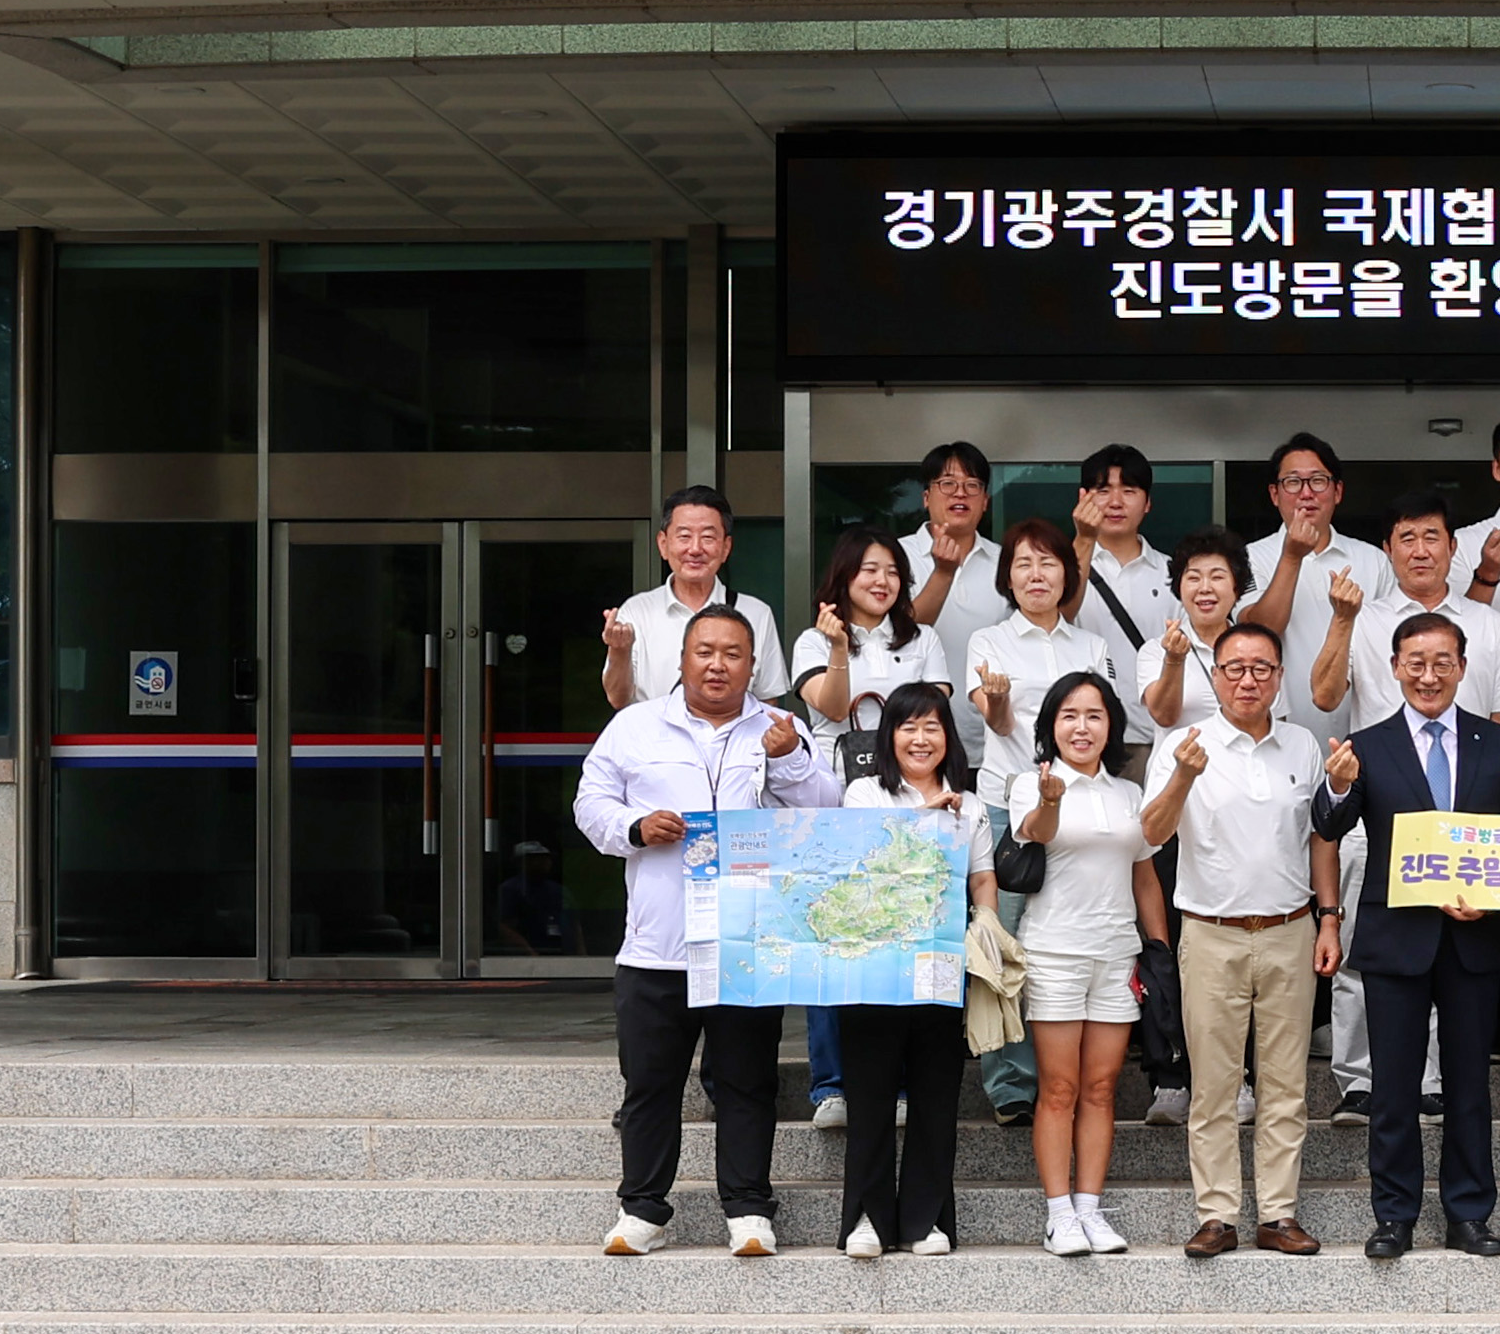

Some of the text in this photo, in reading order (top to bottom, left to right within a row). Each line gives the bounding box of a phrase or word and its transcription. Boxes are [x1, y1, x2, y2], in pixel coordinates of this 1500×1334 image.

[883, 186, 1295, 250] 경기광주경찰서
[1110, 258, 1404, 320] 진도방문을
[1400, 853, 1451, 884] 진도
